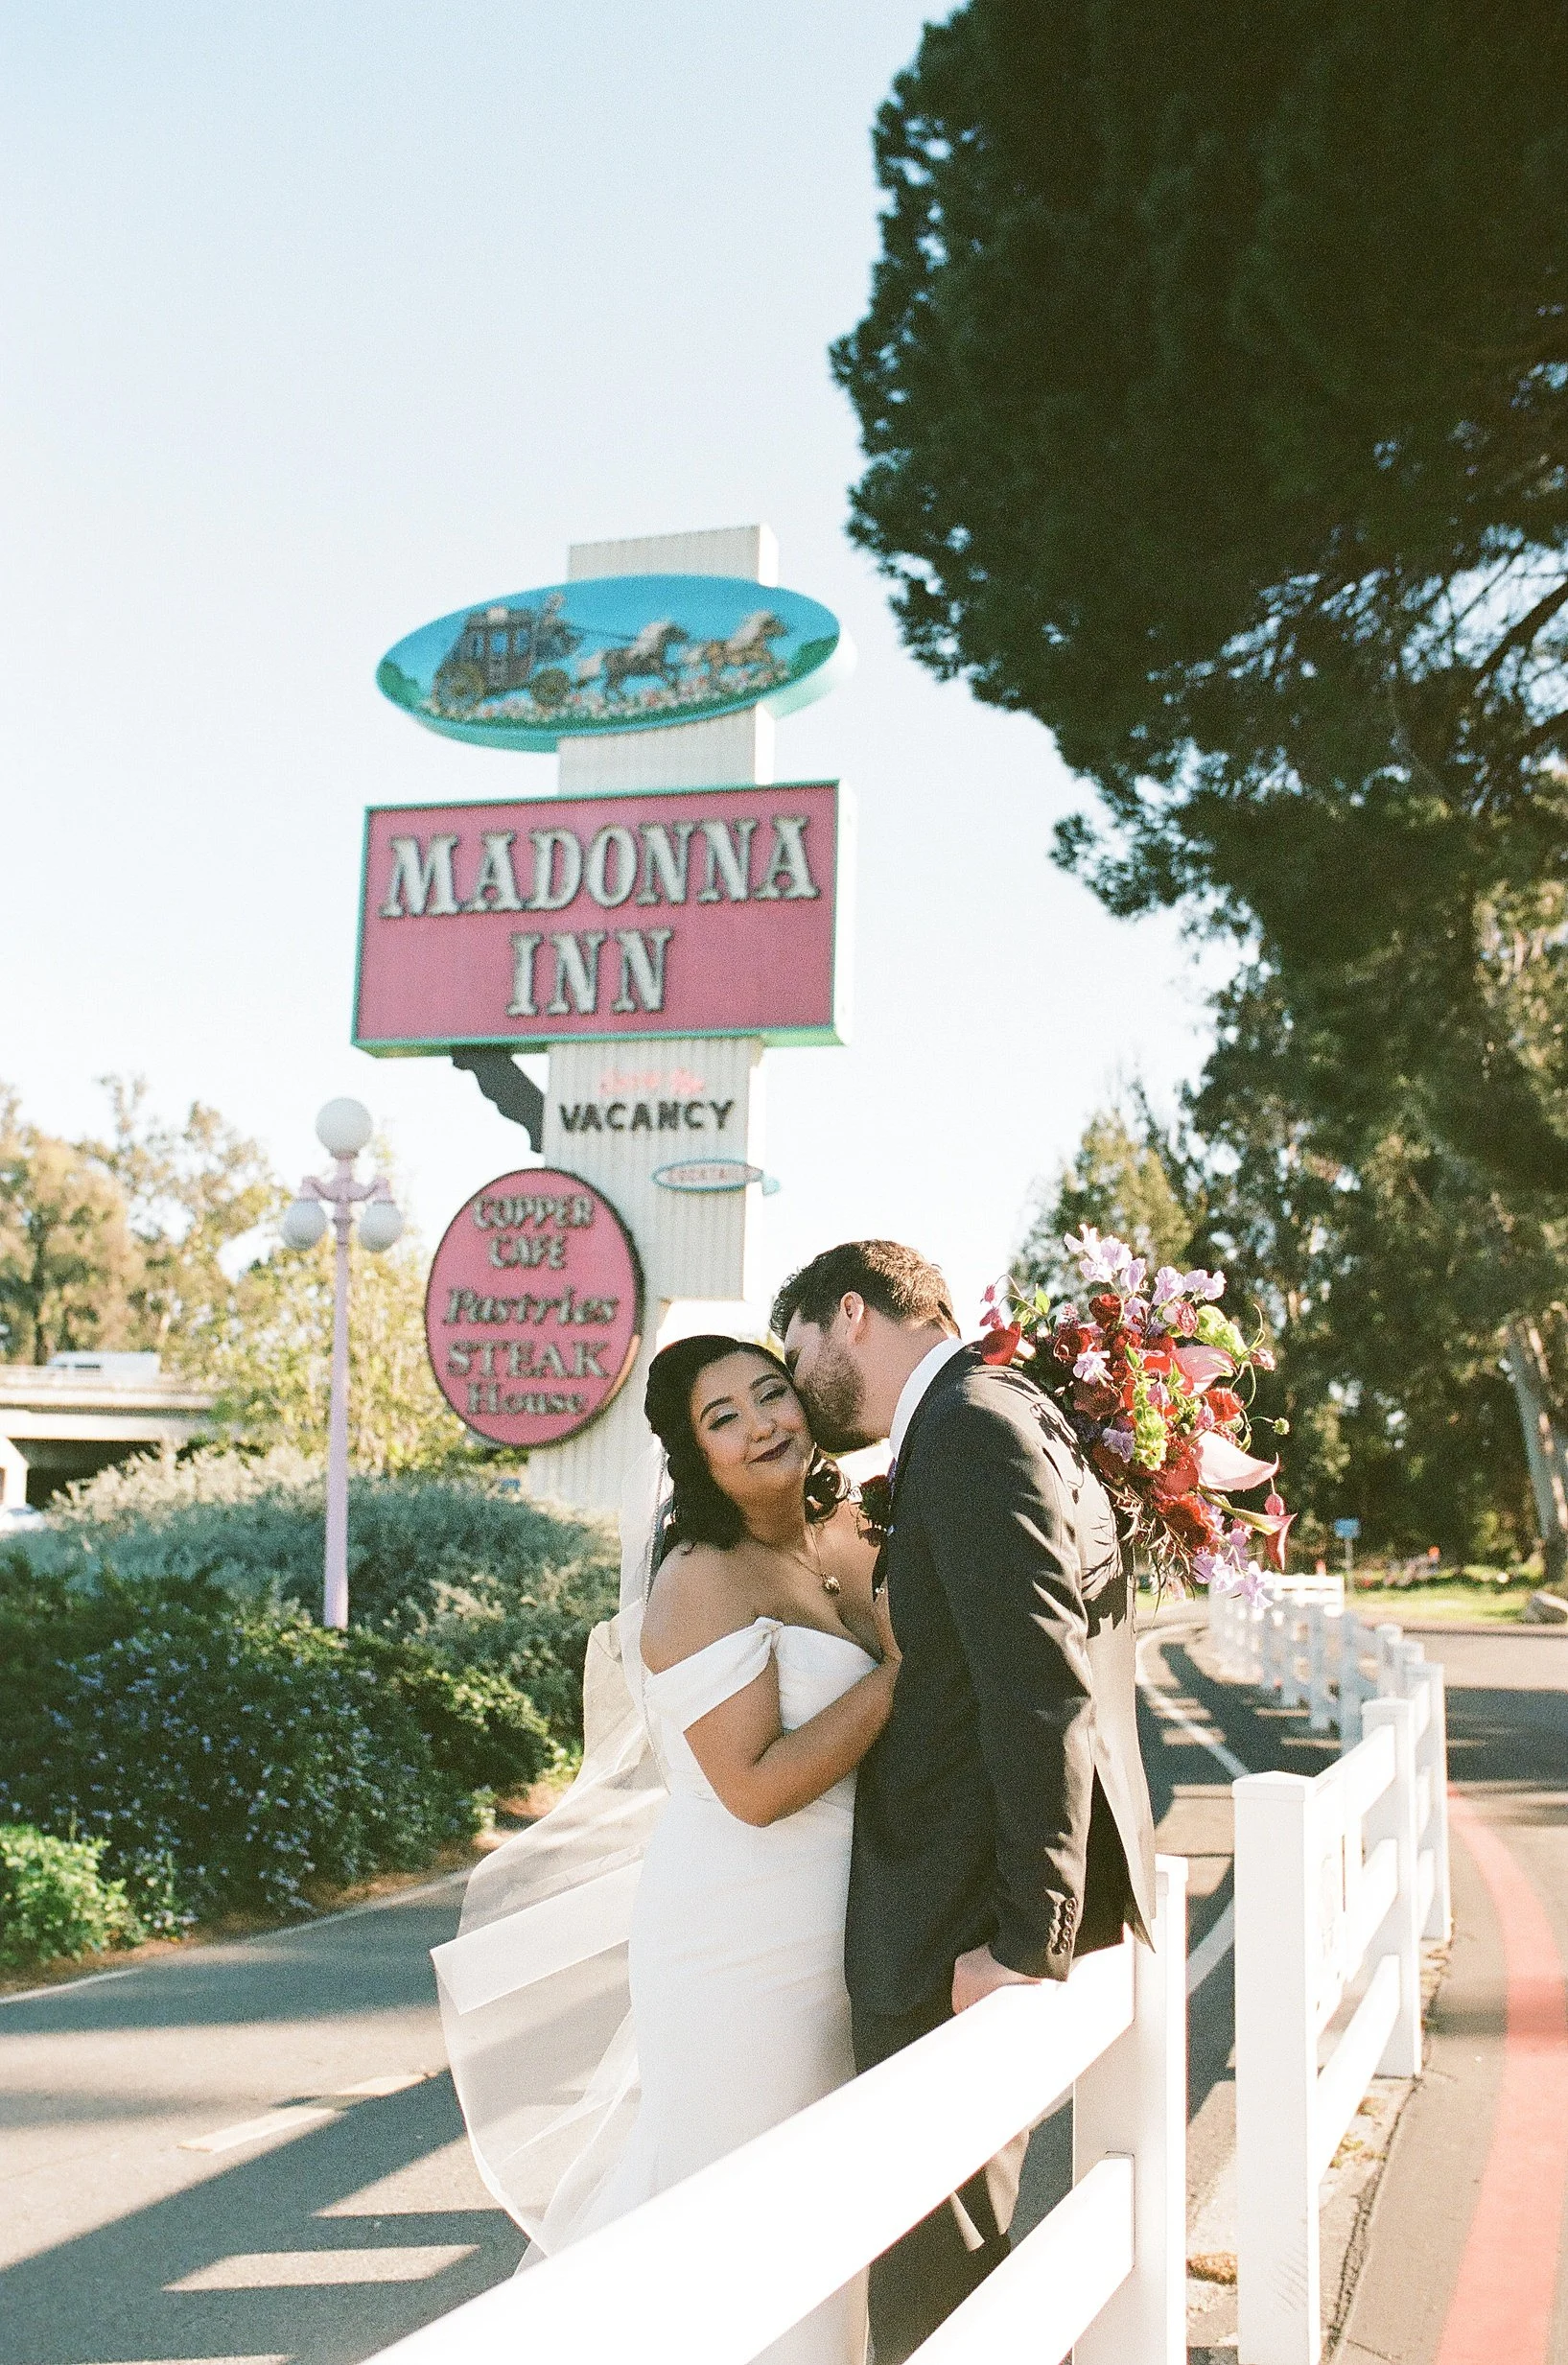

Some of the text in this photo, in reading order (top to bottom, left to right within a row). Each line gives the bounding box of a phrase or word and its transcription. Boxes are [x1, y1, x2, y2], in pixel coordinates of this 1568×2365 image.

[380, 815, 819, 918] MADONNA
[505, 928, 671, 1017] INN
[559, 1099, 735, 1133] VACANCY
[473, 1194, 595, 1229] COPPER
[443, 1284, 619, 1325] Pastries
[445, 1339, 610, 1378] STEAK
[465, 1382, 587, 1415] House
